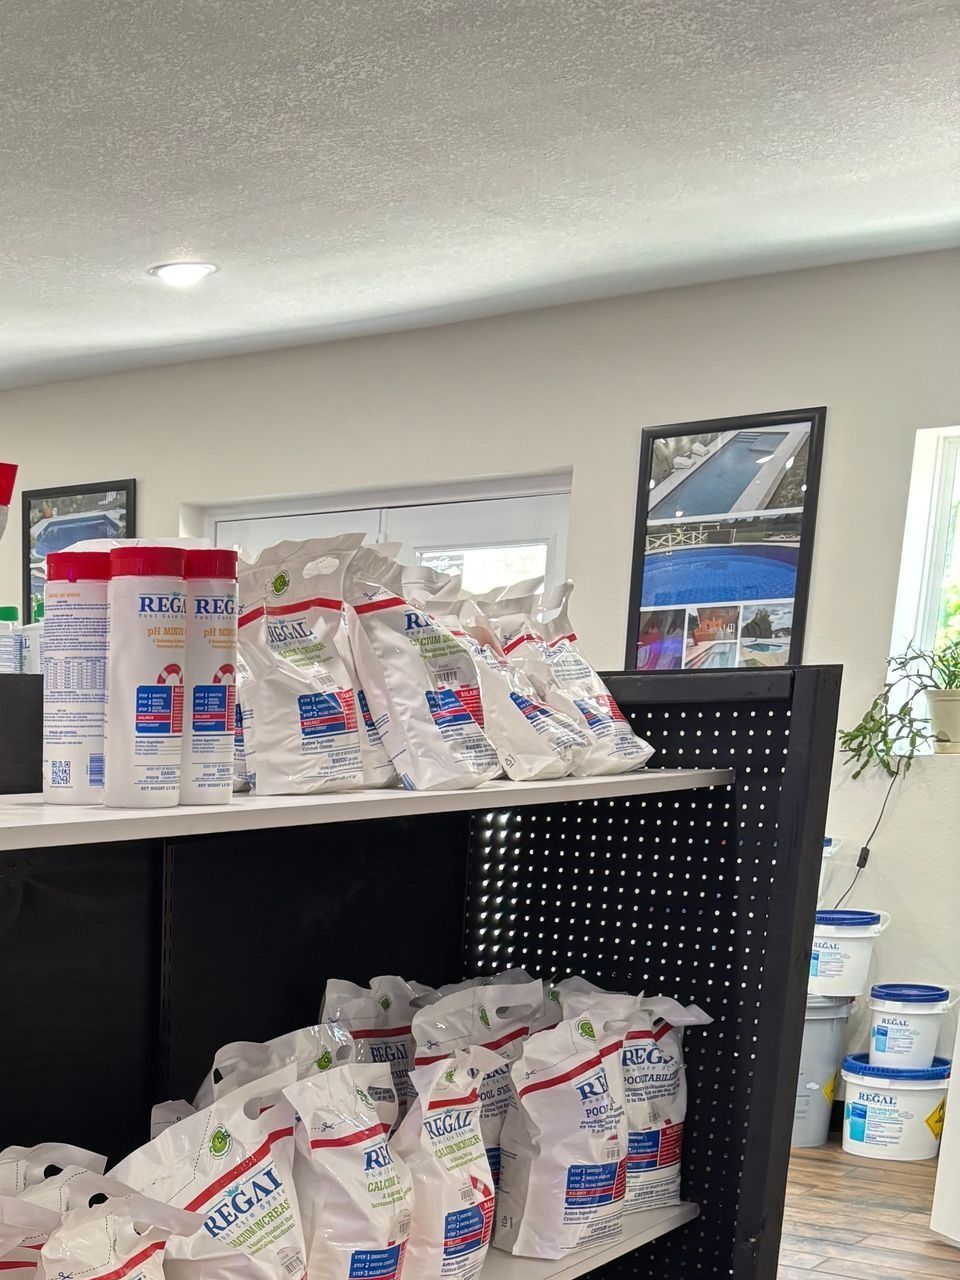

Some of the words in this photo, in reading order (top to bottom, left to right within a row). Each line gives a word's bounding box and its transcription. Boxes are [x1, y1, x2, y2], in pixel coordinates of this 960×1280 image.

[195, 599, 236, 614] REG
[882, 1017, 909, 1027] REGAL
[859, 1093, 896, 1104] REGAL
[424, 1110, 472, 1140] REGAL
